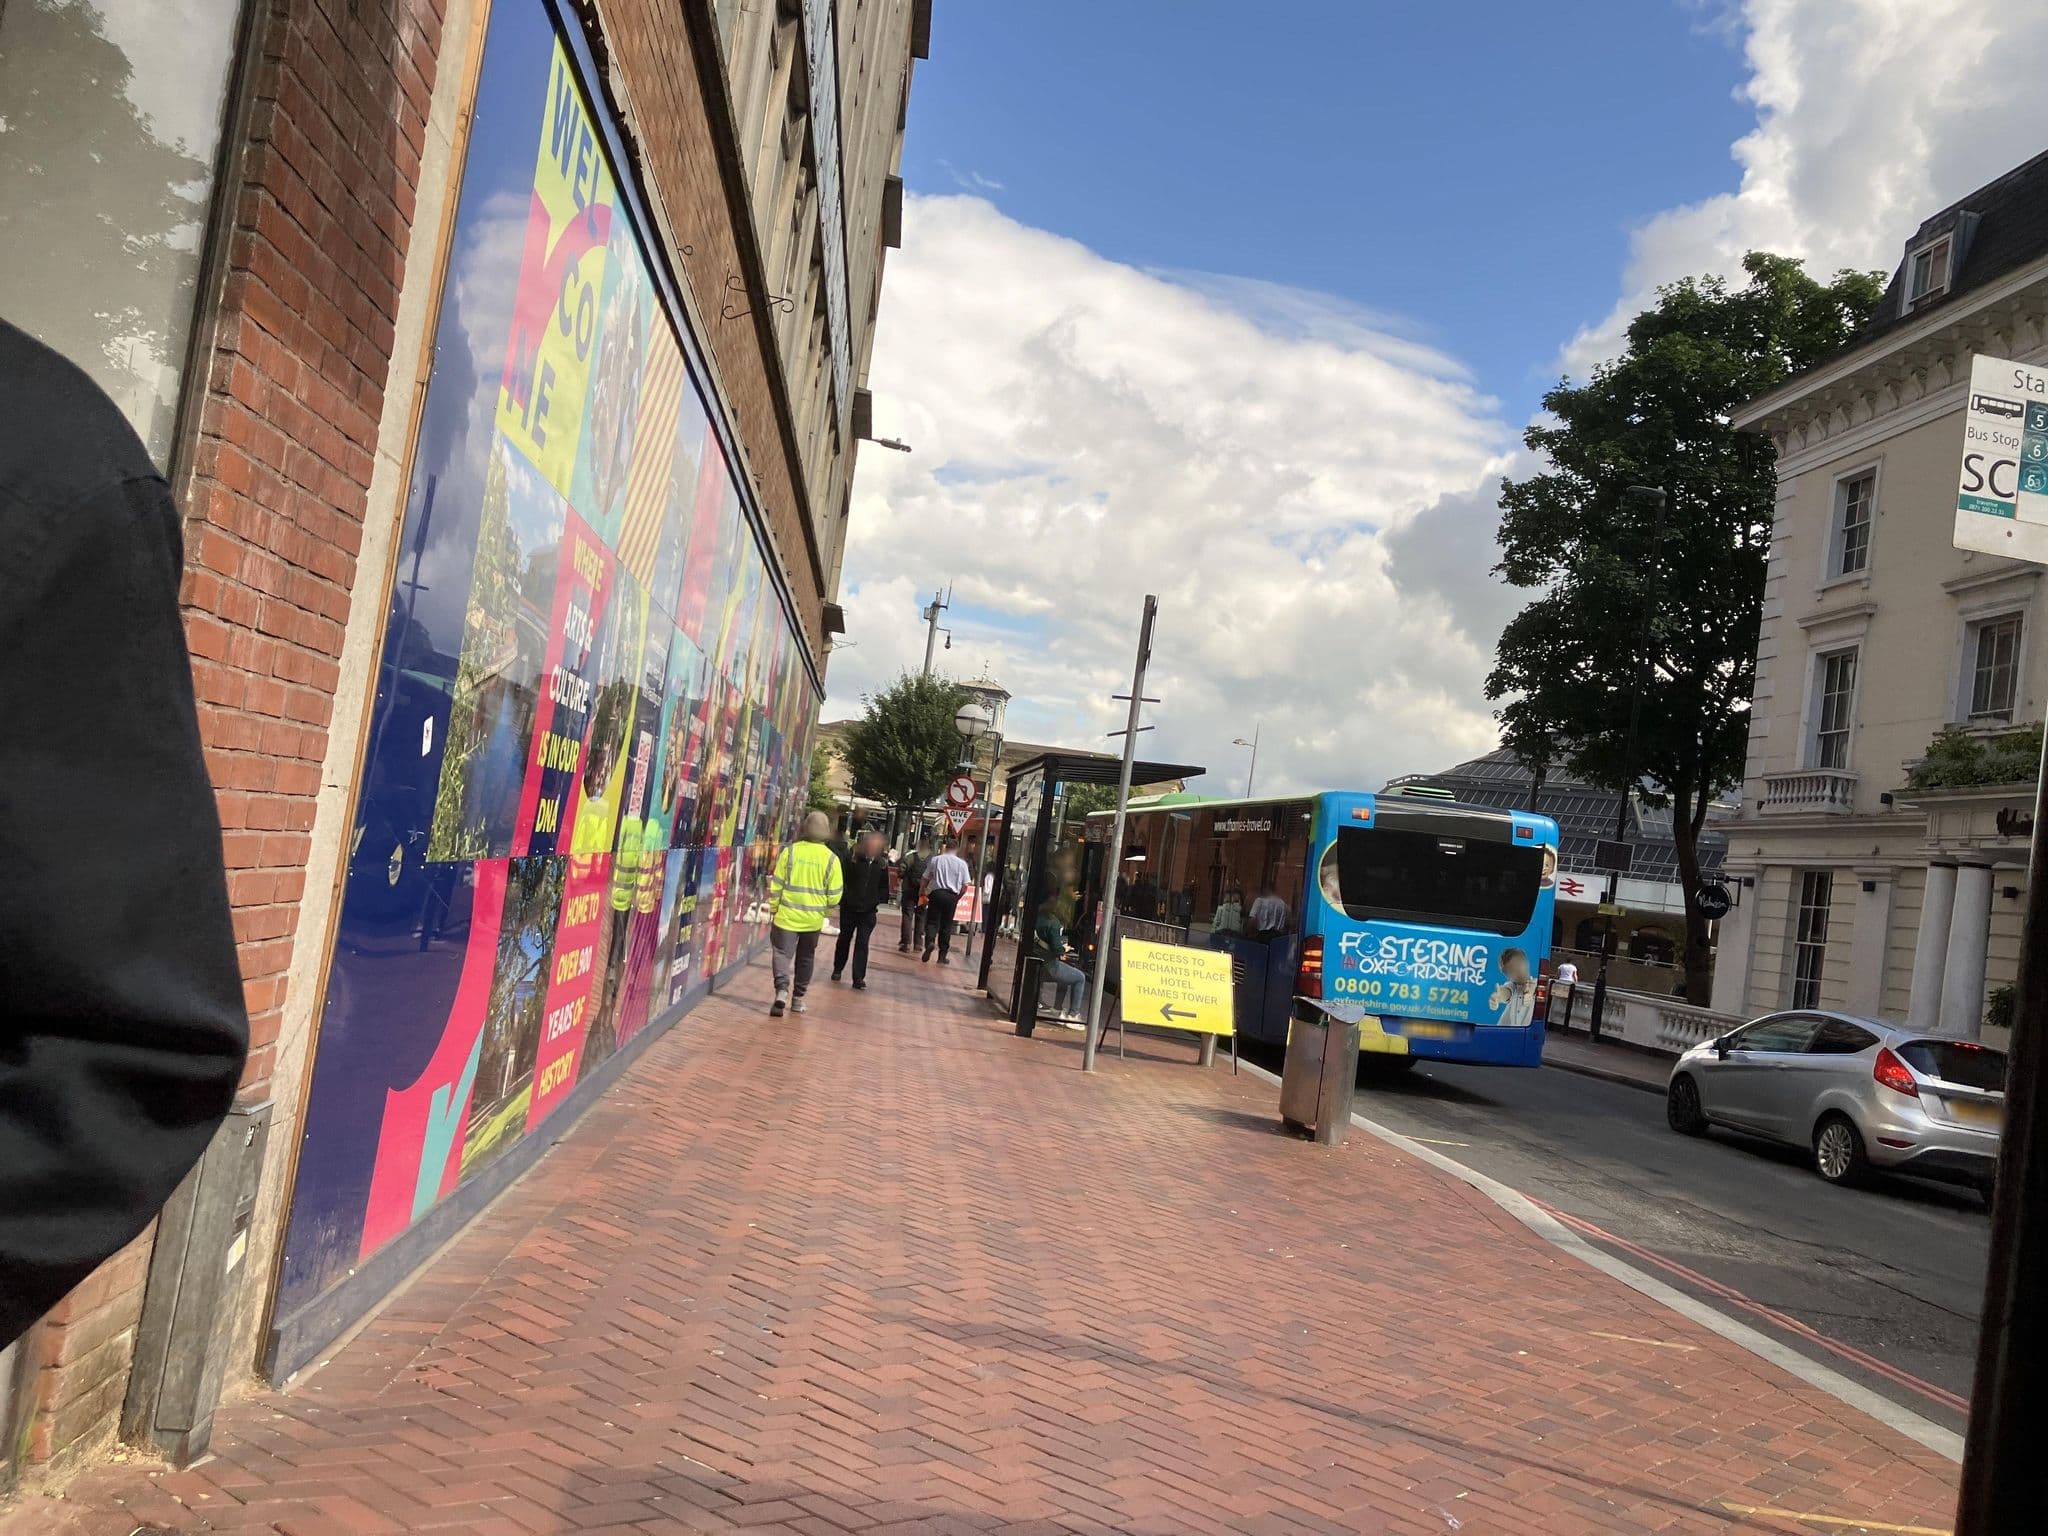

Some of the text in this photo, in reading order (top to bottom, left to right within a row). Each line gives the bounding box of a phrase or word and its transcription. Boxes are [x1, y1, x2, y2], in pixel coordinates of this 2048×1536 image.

[551, 60, 600, 239] WEL
[559, 252, 594, 363] CO
[506, 325, 556, 451] ME
[1967, 426, 1989, 442] Bus
[1992, 431, 2020, 449] Stop
[2036, 414, 2044, 428] 5
[2033, 444, 2041, 458] 6
[1961, 453, 2017, 499] SC
[573, 533, 604, 592] WHERE
[562, 601, 594, 653] ARTS &
[549, 663, 590, 714] CULTURE
[536, 729, 581, 774] IS IN OUR
[534, 798, 559, 833] DNA
[950, 810, 968, 818] GIVE
[564, 892, 599, 928] HOME TO
[556, 945, 593, 986] OVER 900
[1127, 959, 1226, 982] MERCHANTS PLACE
[1147, 951, 1205, 967] ACCESS TO
[1338, 931, 1488, 973] FOSTERING
[1136, 985, 1218, 1006] THAMES TOWER
[1160, 976, 1194, 990] HOTEL
[1334, 977, 1469, 1005] 0800 783 5724
[546, 996, 586, 1043] YEARS OF
[538, 1048, 576, 1100] HISTORY
